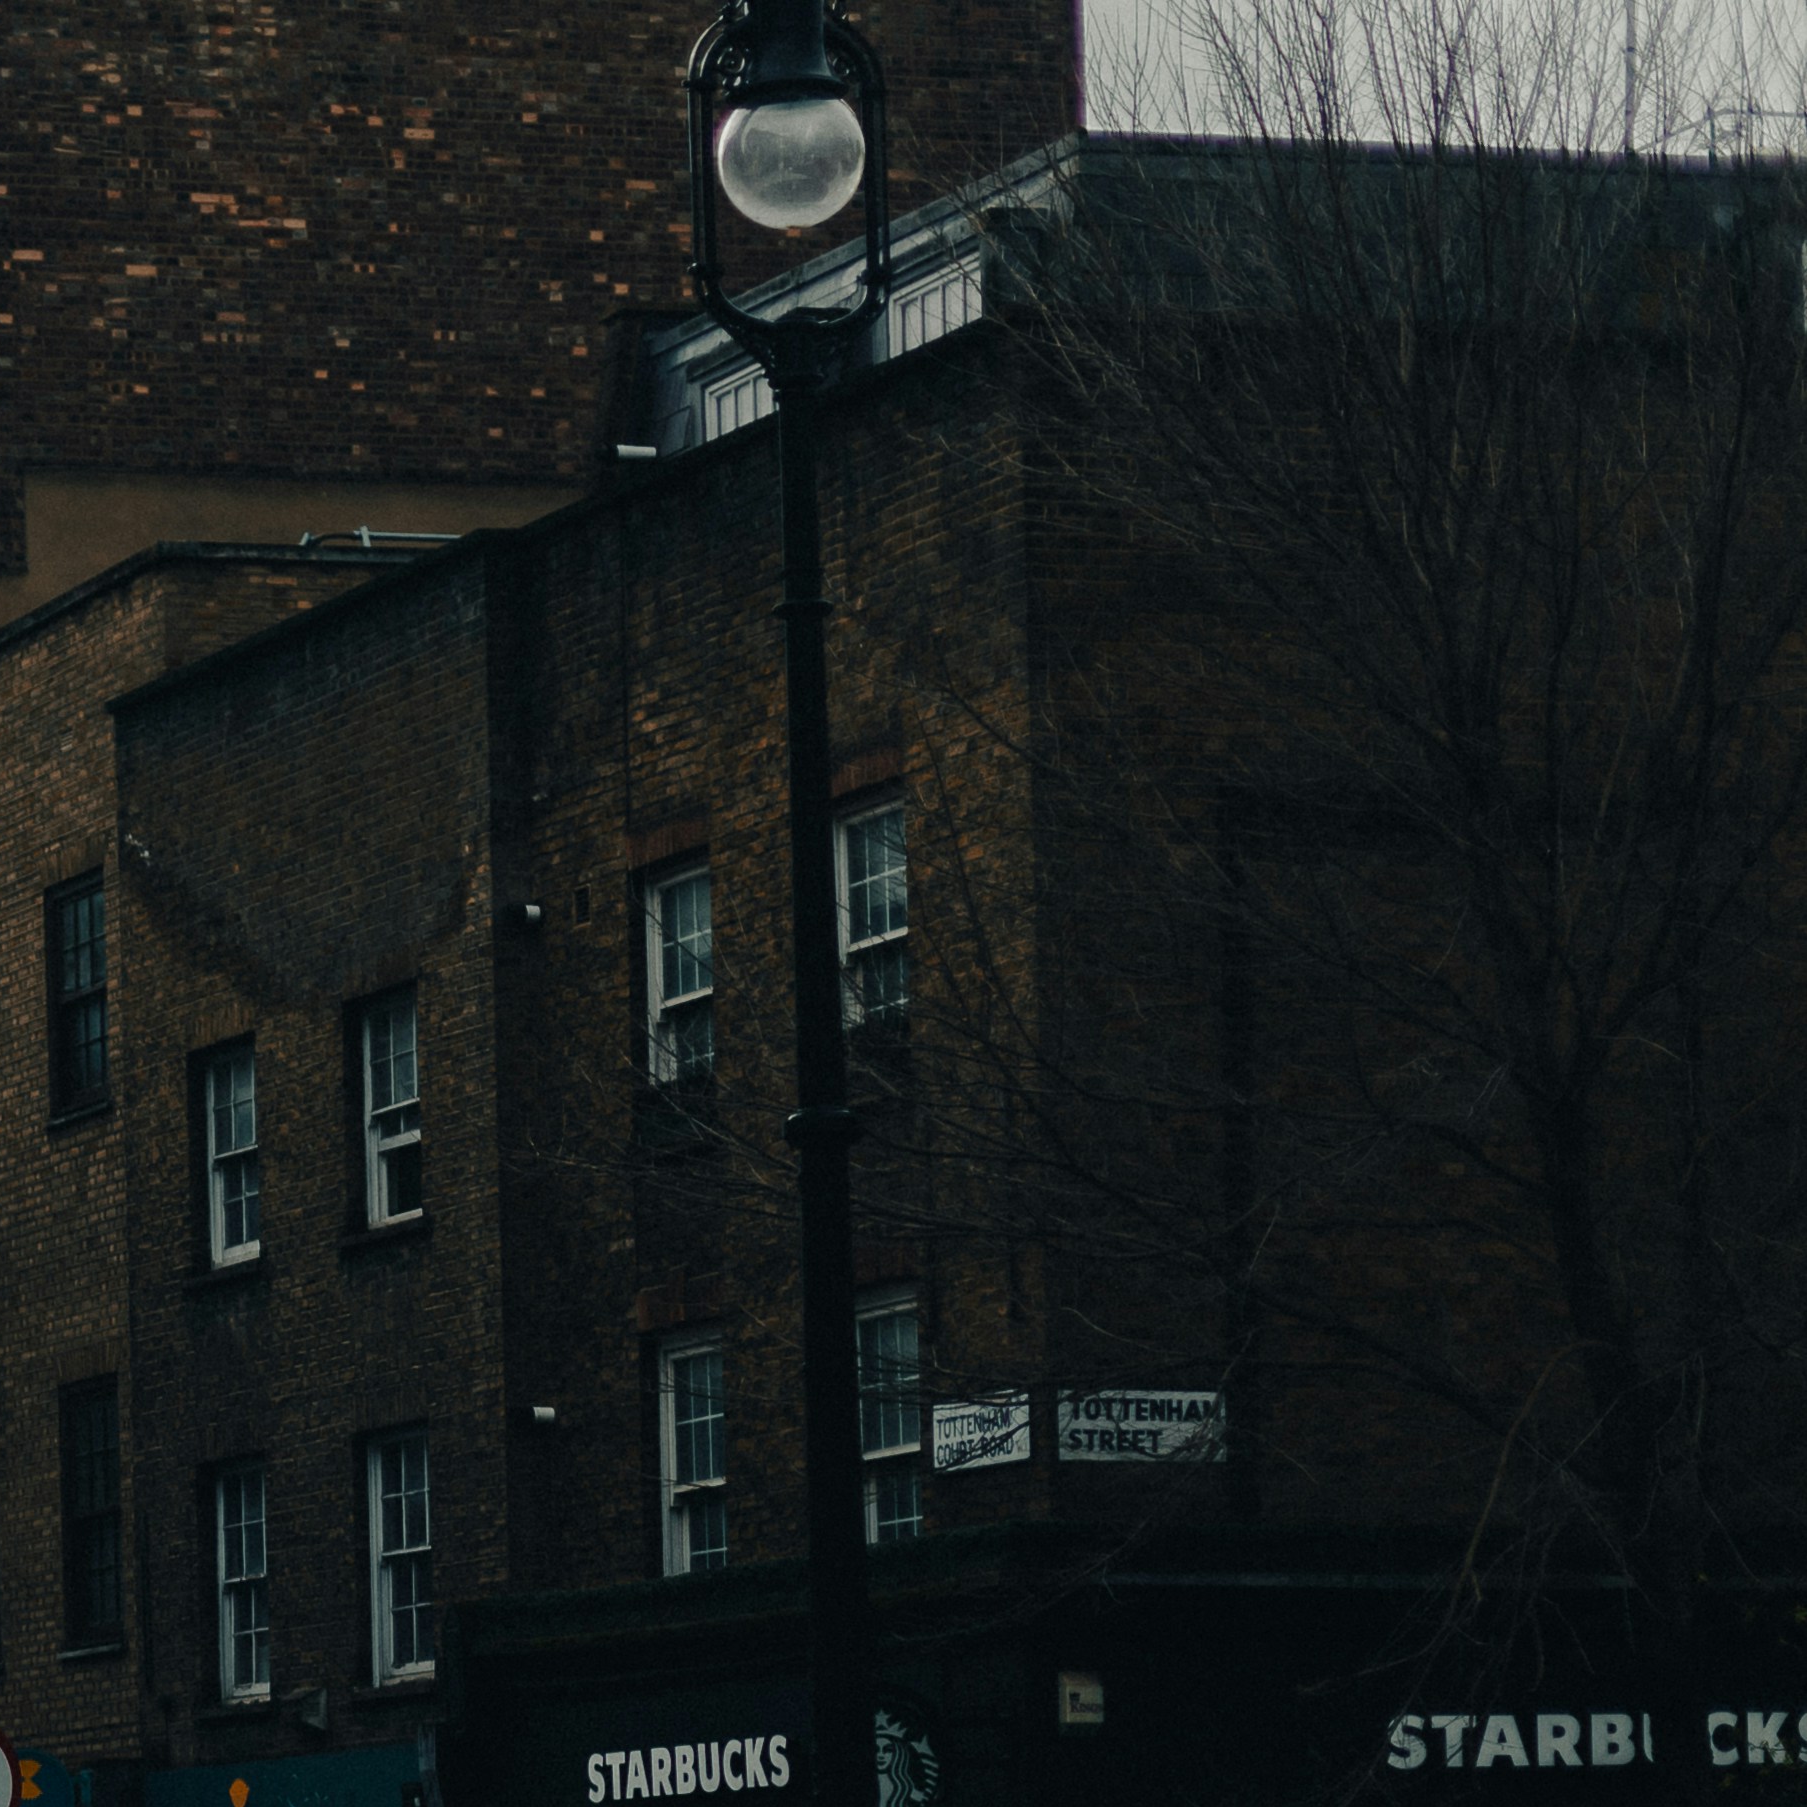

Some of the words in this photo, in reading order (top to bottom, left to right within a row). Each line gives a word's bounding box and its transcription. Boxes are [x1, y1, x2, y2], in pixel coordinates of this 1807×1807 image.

[936, 1407, 1011, 1440] TOTTENHAM
[1073, 1399, 1219, 1421] TOTTENHAM
[1067, 1428, 1163, 1451] STREET
[1386, 1710, 1807, 1770] STARBCK
[588, 1734, 790, 1804] STARBUCKS
